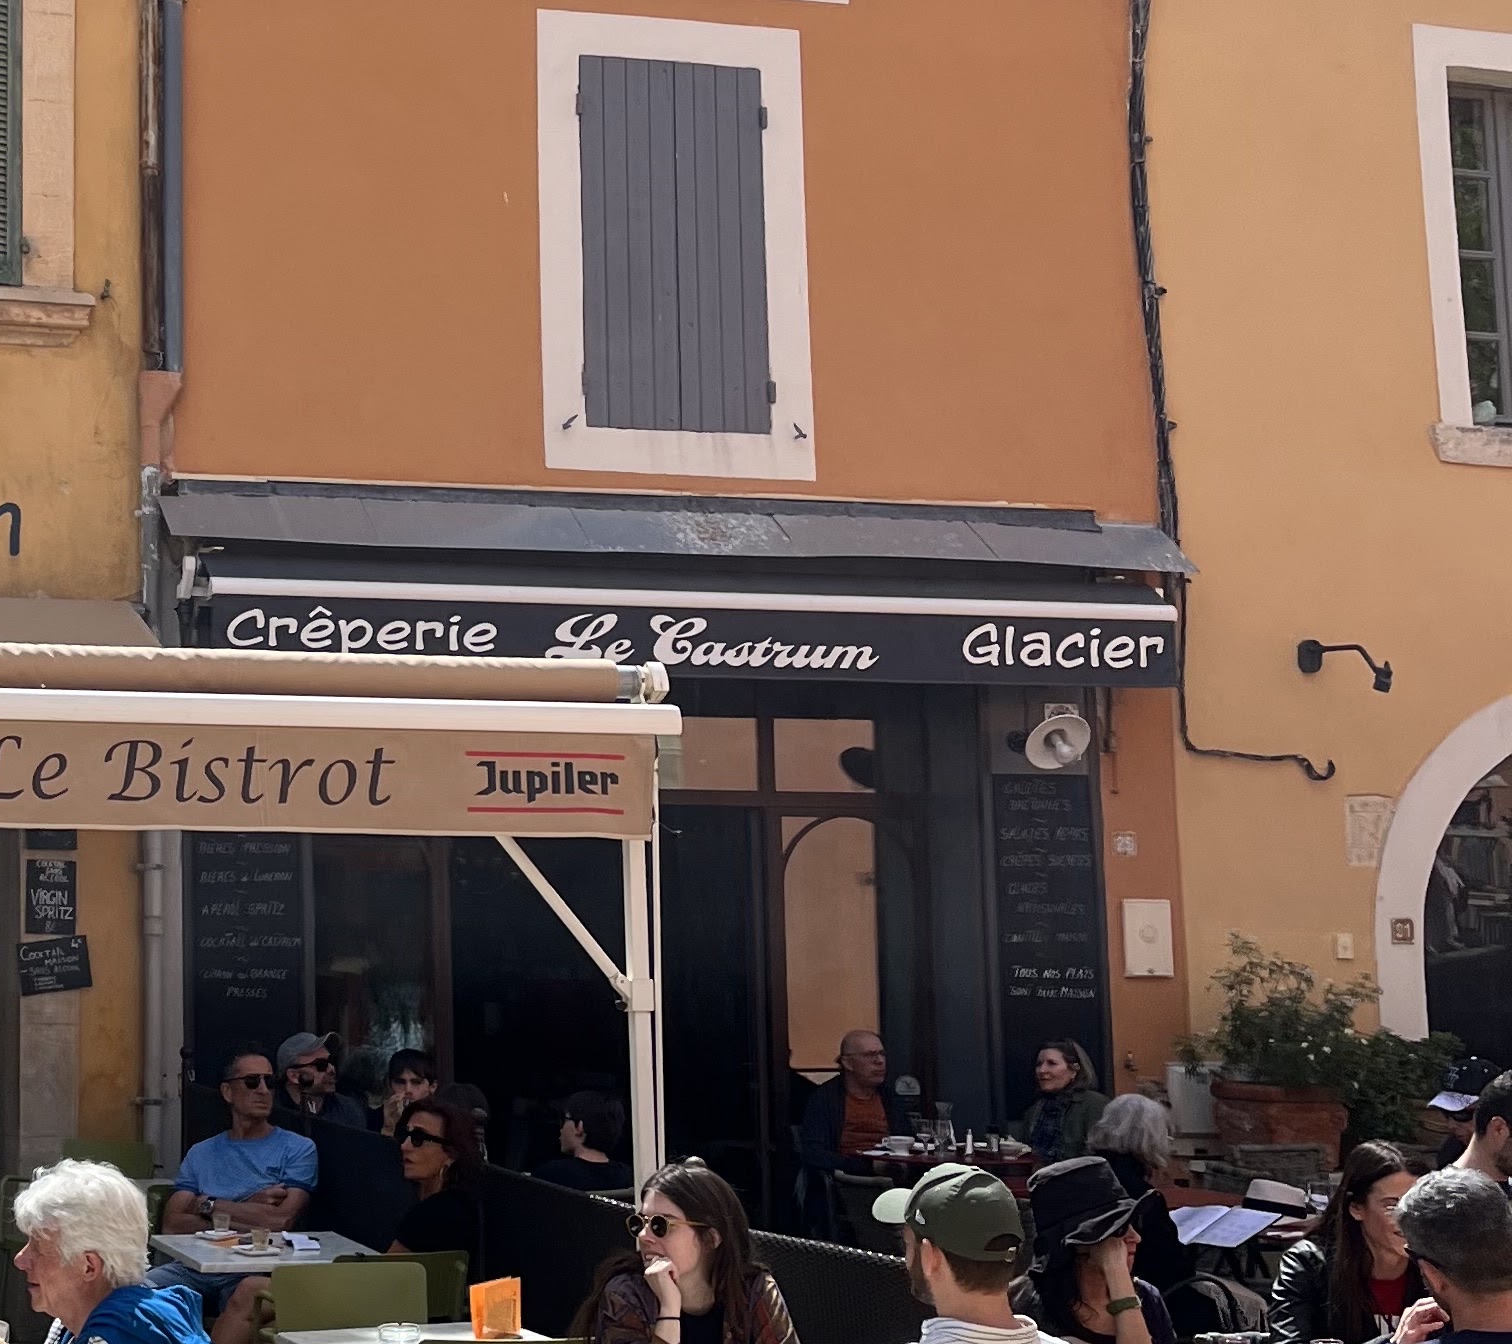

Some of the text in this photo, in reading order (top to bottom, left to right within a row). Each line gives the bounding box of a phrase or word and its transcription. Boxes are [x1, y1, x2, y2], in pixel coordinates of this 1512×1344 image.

[226, 605, 880, 670] Crêperie Le Castrum
[961, 621, 1166, 670] Glacier
[102, 736, 397, 807] Bistrot
[474, 759, 621, 805] Jupiler
[30, 888, 69, 906] VIRGIN
[35, 905, 75, 921] SPRITZ
